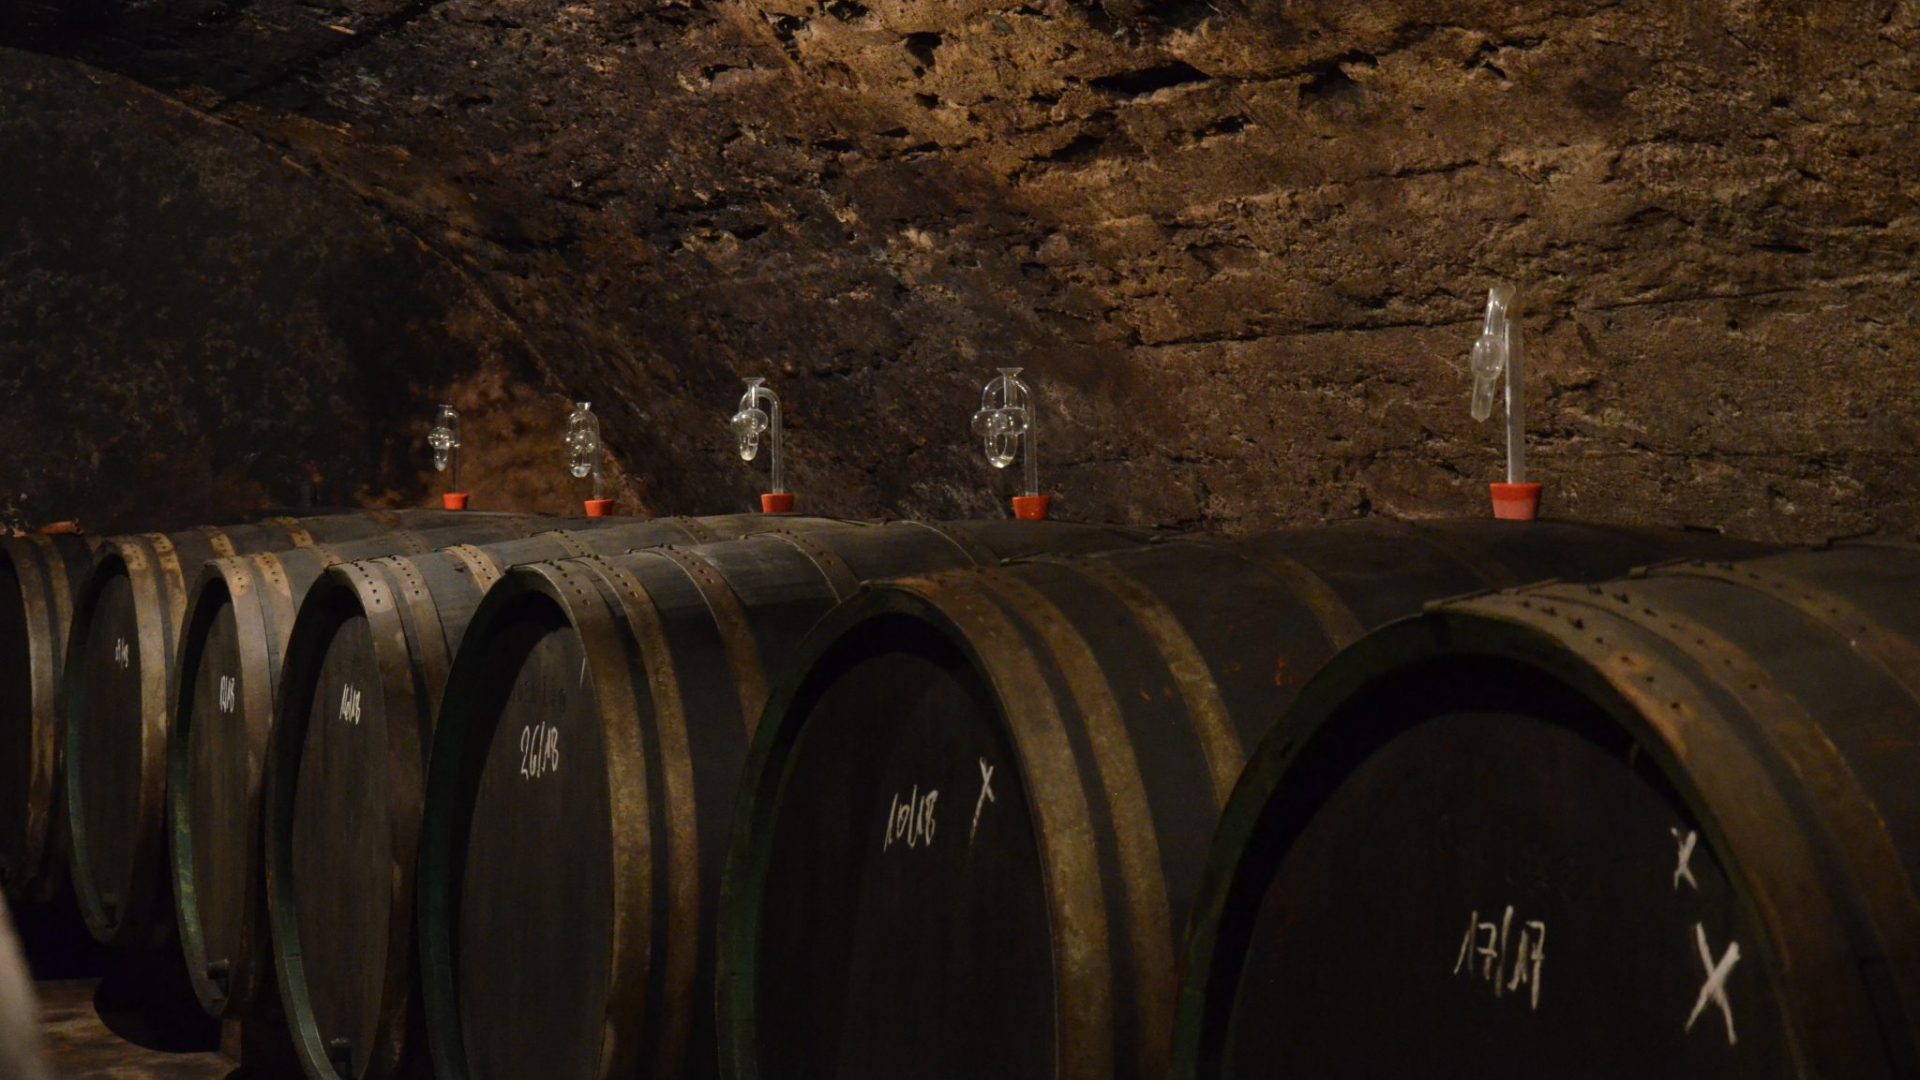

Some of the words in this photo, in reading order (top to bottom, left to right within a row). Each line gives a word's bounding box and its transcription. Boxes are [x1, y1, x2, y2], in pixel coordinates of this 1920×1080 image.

[519, 720, 561, 781] 26/18
[883, 784, 940, 853] 10/18
[1453, 904, 1546, 1011] 17/17
